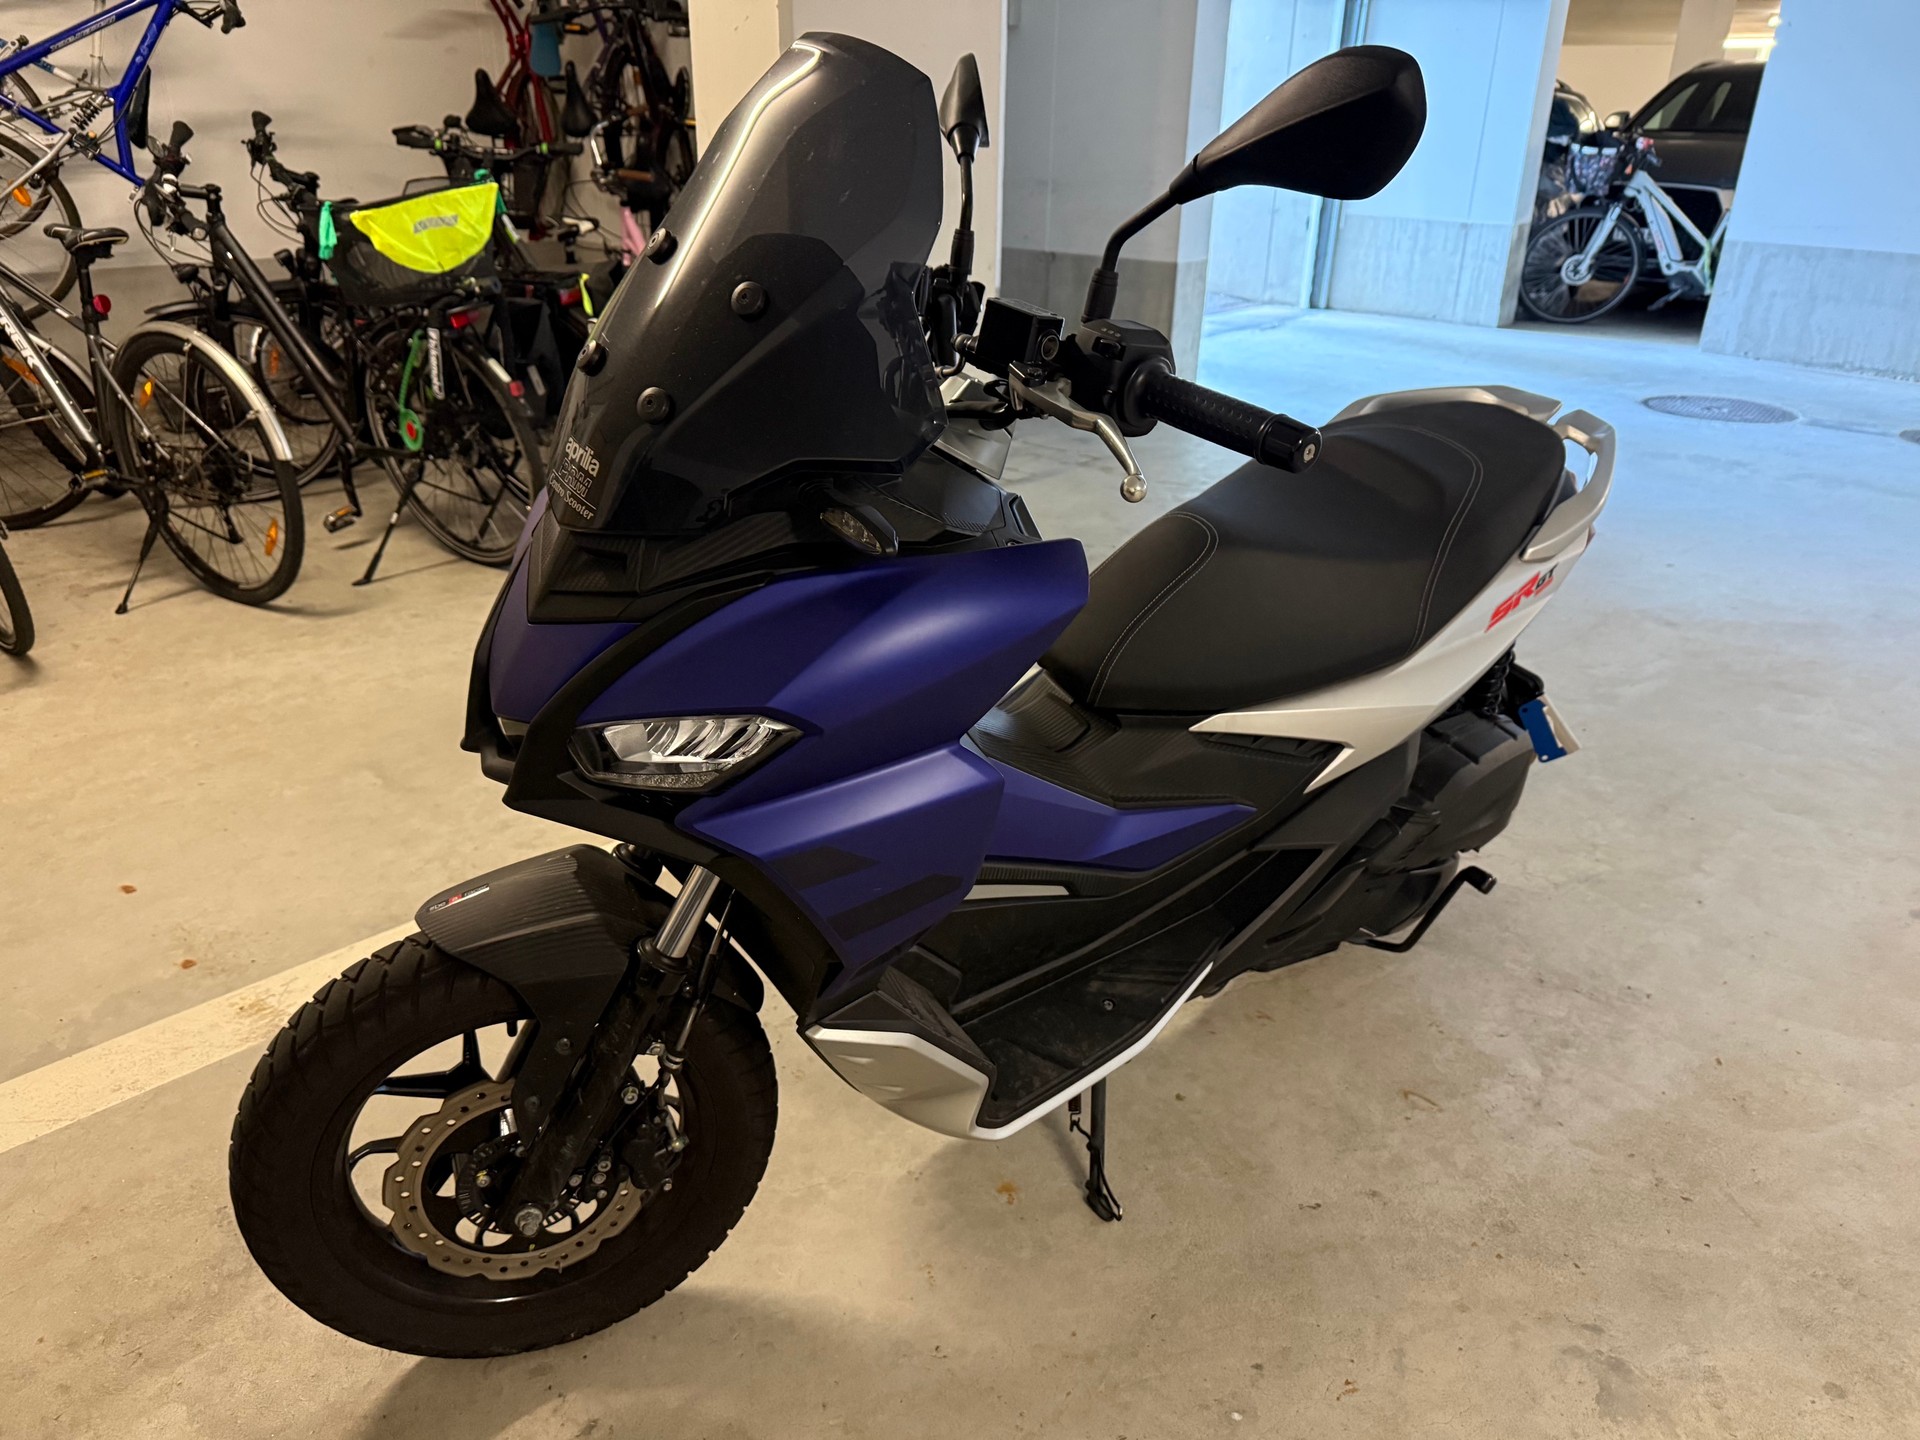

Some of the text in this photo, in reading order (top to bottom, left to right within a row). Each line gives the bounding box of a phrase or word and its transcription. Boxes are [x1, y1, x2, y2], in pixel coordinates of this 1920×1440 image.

[0, 308, 38, 369] REK
[566, 437, 600, 477] aprilia
[549, 473, 594, 520] Centro Scooter
[1484, 571, 1540, 633] SR
